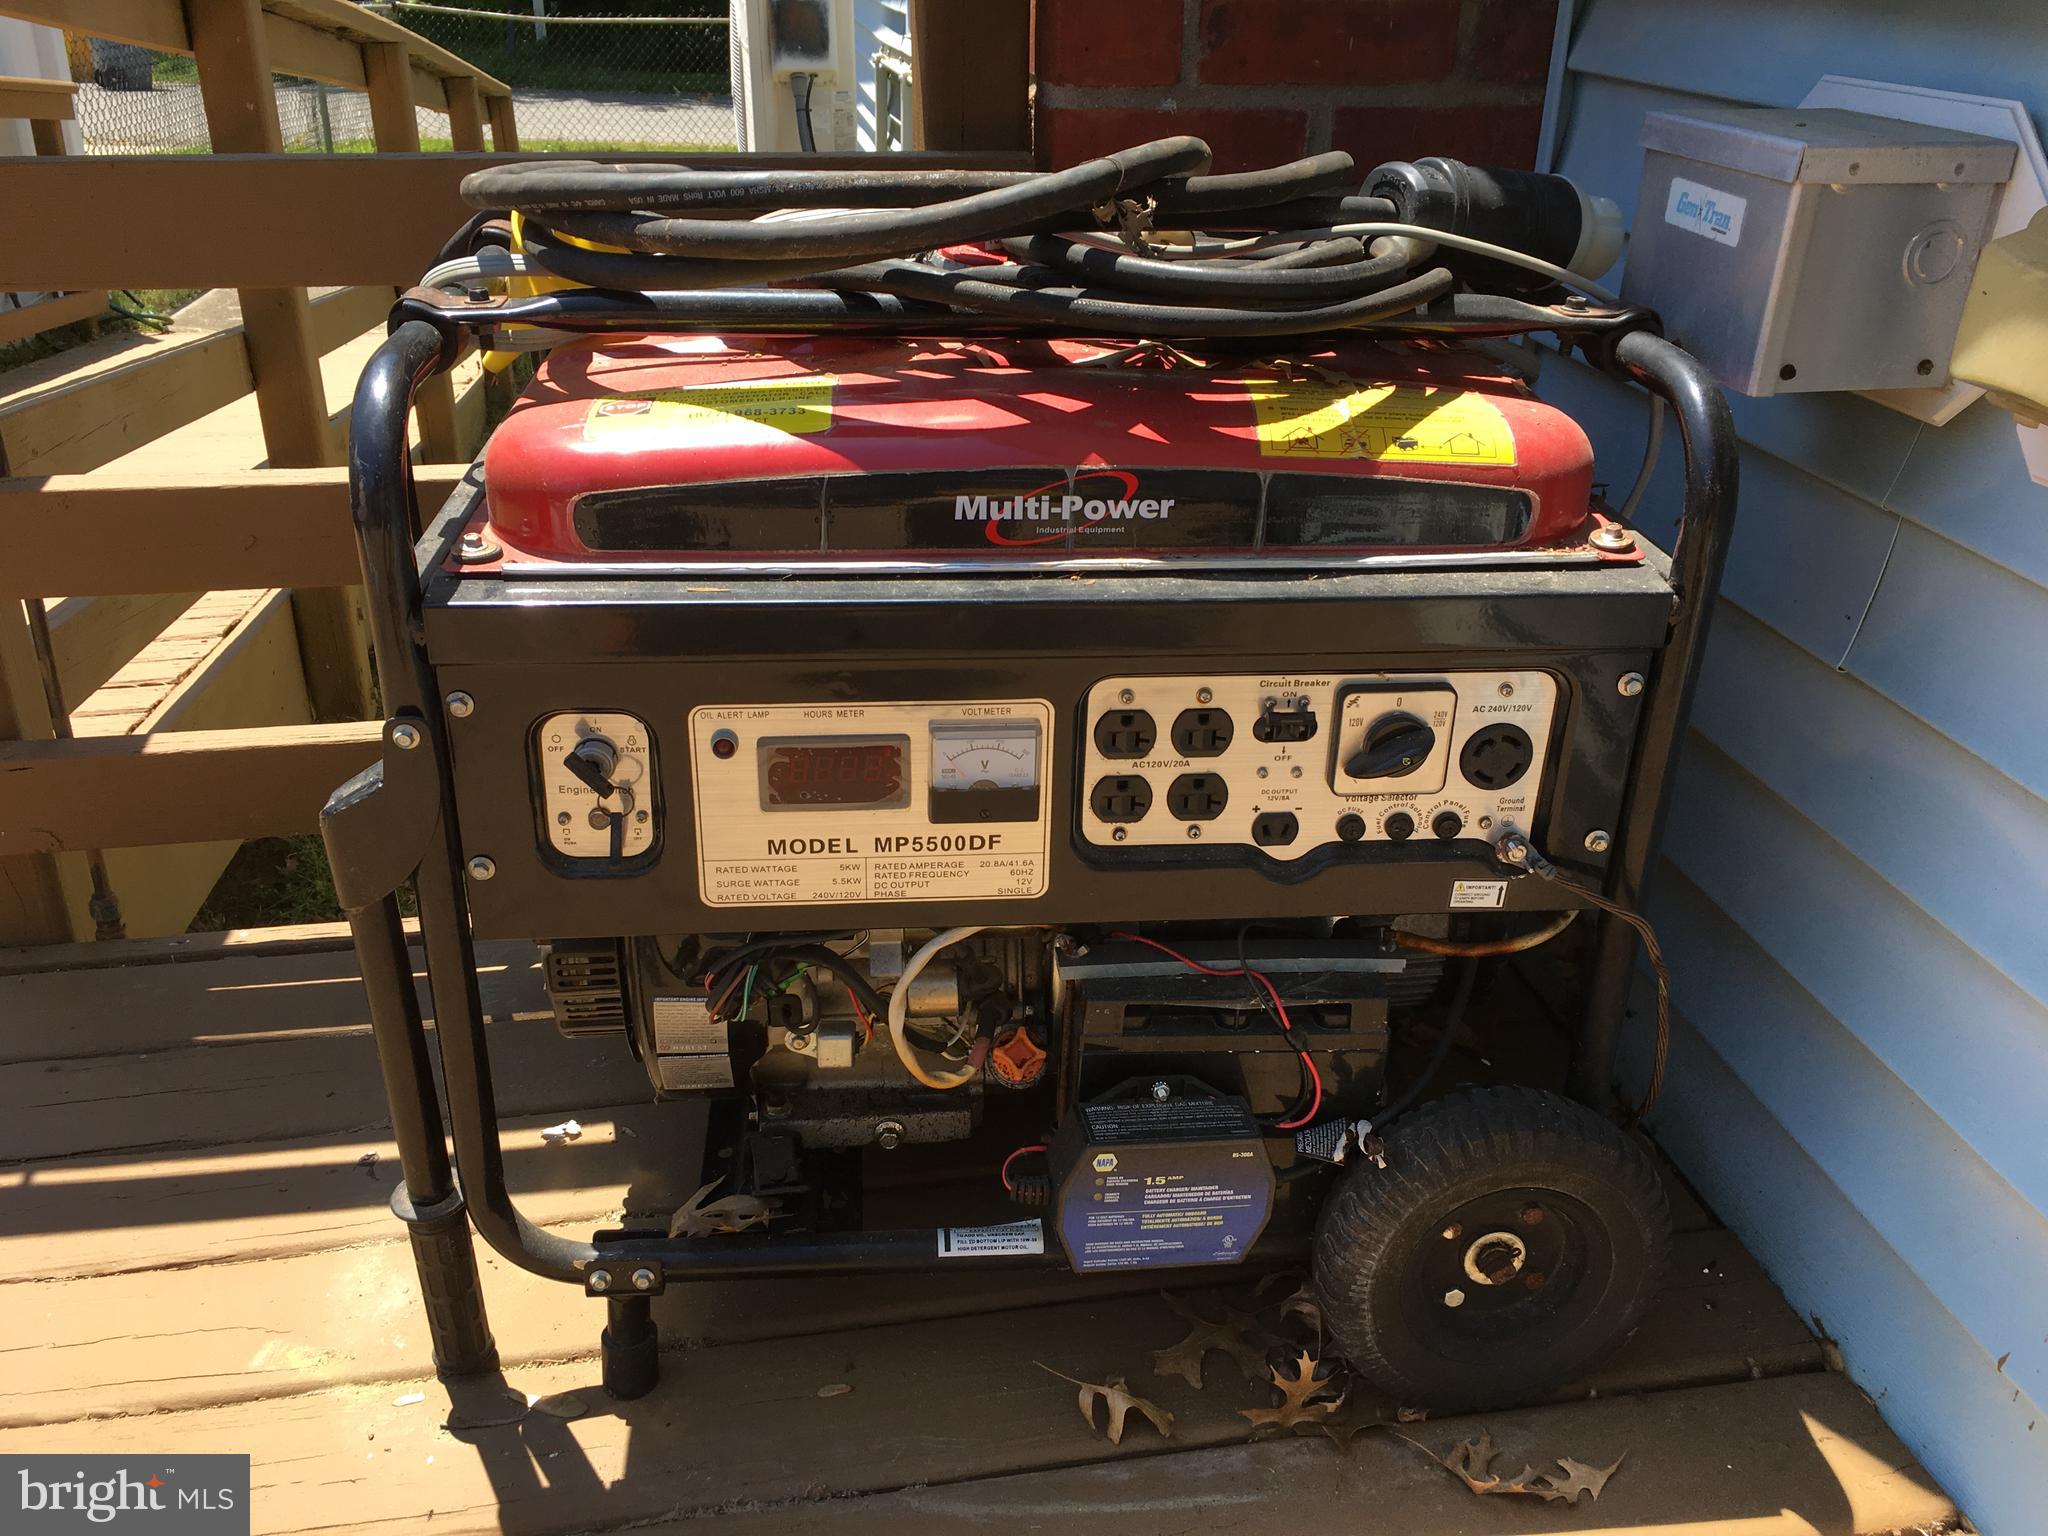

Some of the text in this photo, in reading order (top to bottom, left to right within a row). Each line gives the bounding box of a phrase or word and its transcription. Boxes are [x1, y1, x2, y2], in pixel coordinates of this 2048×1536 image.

[707, 189, 727, 199] VOLT
[730, 187, 745, 196] 600
[628, 196, 643, 205] USA
[647, 195, 655, 204] IN
[657, 193, 679, 203] MADE
[735, 407, 806, 416] 968-3733
[954, 494, 1176, 522] Multi-Power
[1036, 526, 1126, 535] Industrial Equipment
[1259, 679, 1331, 688] Circuit Breaker
[961, 707, 1012, 716] VOLT METER
[1472, 704, 1533, 713] AC 240V/120V
[700, 710, 770, 720] OIL ALERT LAMP
[803, 709, 865, 719] HOURS METER
[1274, 754, 1293, 762] OFF
[980, 759, 989, 770] V
[1131, 760, 1191, 769] AC120V/20A
[558, 785, 597, 795] Engine
[1345, 794, 1418, 804] Voltage Selector
[1499, 797, 1526, 805] Ground
[1378, 802, 1409, 818] Control
[1496, 805, 1526, 813] Terminal
[1422, 801, 1442, 830] Control
[1443, 799, 1467, 811] Panel
[767, 834, 1003, 855] MODEL MP5500DF
[715, 863, 861, 874] RATED WATTAGE 5KW
[874, 859, 1034, 871] RATED AMPERAGE 20.8A/41.6A
[874, 872, 907, 880] RATED
[908, 870, 970, 879] FREQUENCY
[716, 877, 862, 888] SURGE WATTAGE 5.5KW
[874, 881, 888, 889] DC
[890, 880, 930, 889] OUTPUT
[717, 891, 862, 902] RATED VOLTAGE 240V/120V
[874, 887, 1033, 898] PHASE SINGLE
[1096, 1158, 1114, 1167] NAPA
[1143, 1176, 1166, 1185] 1.5
